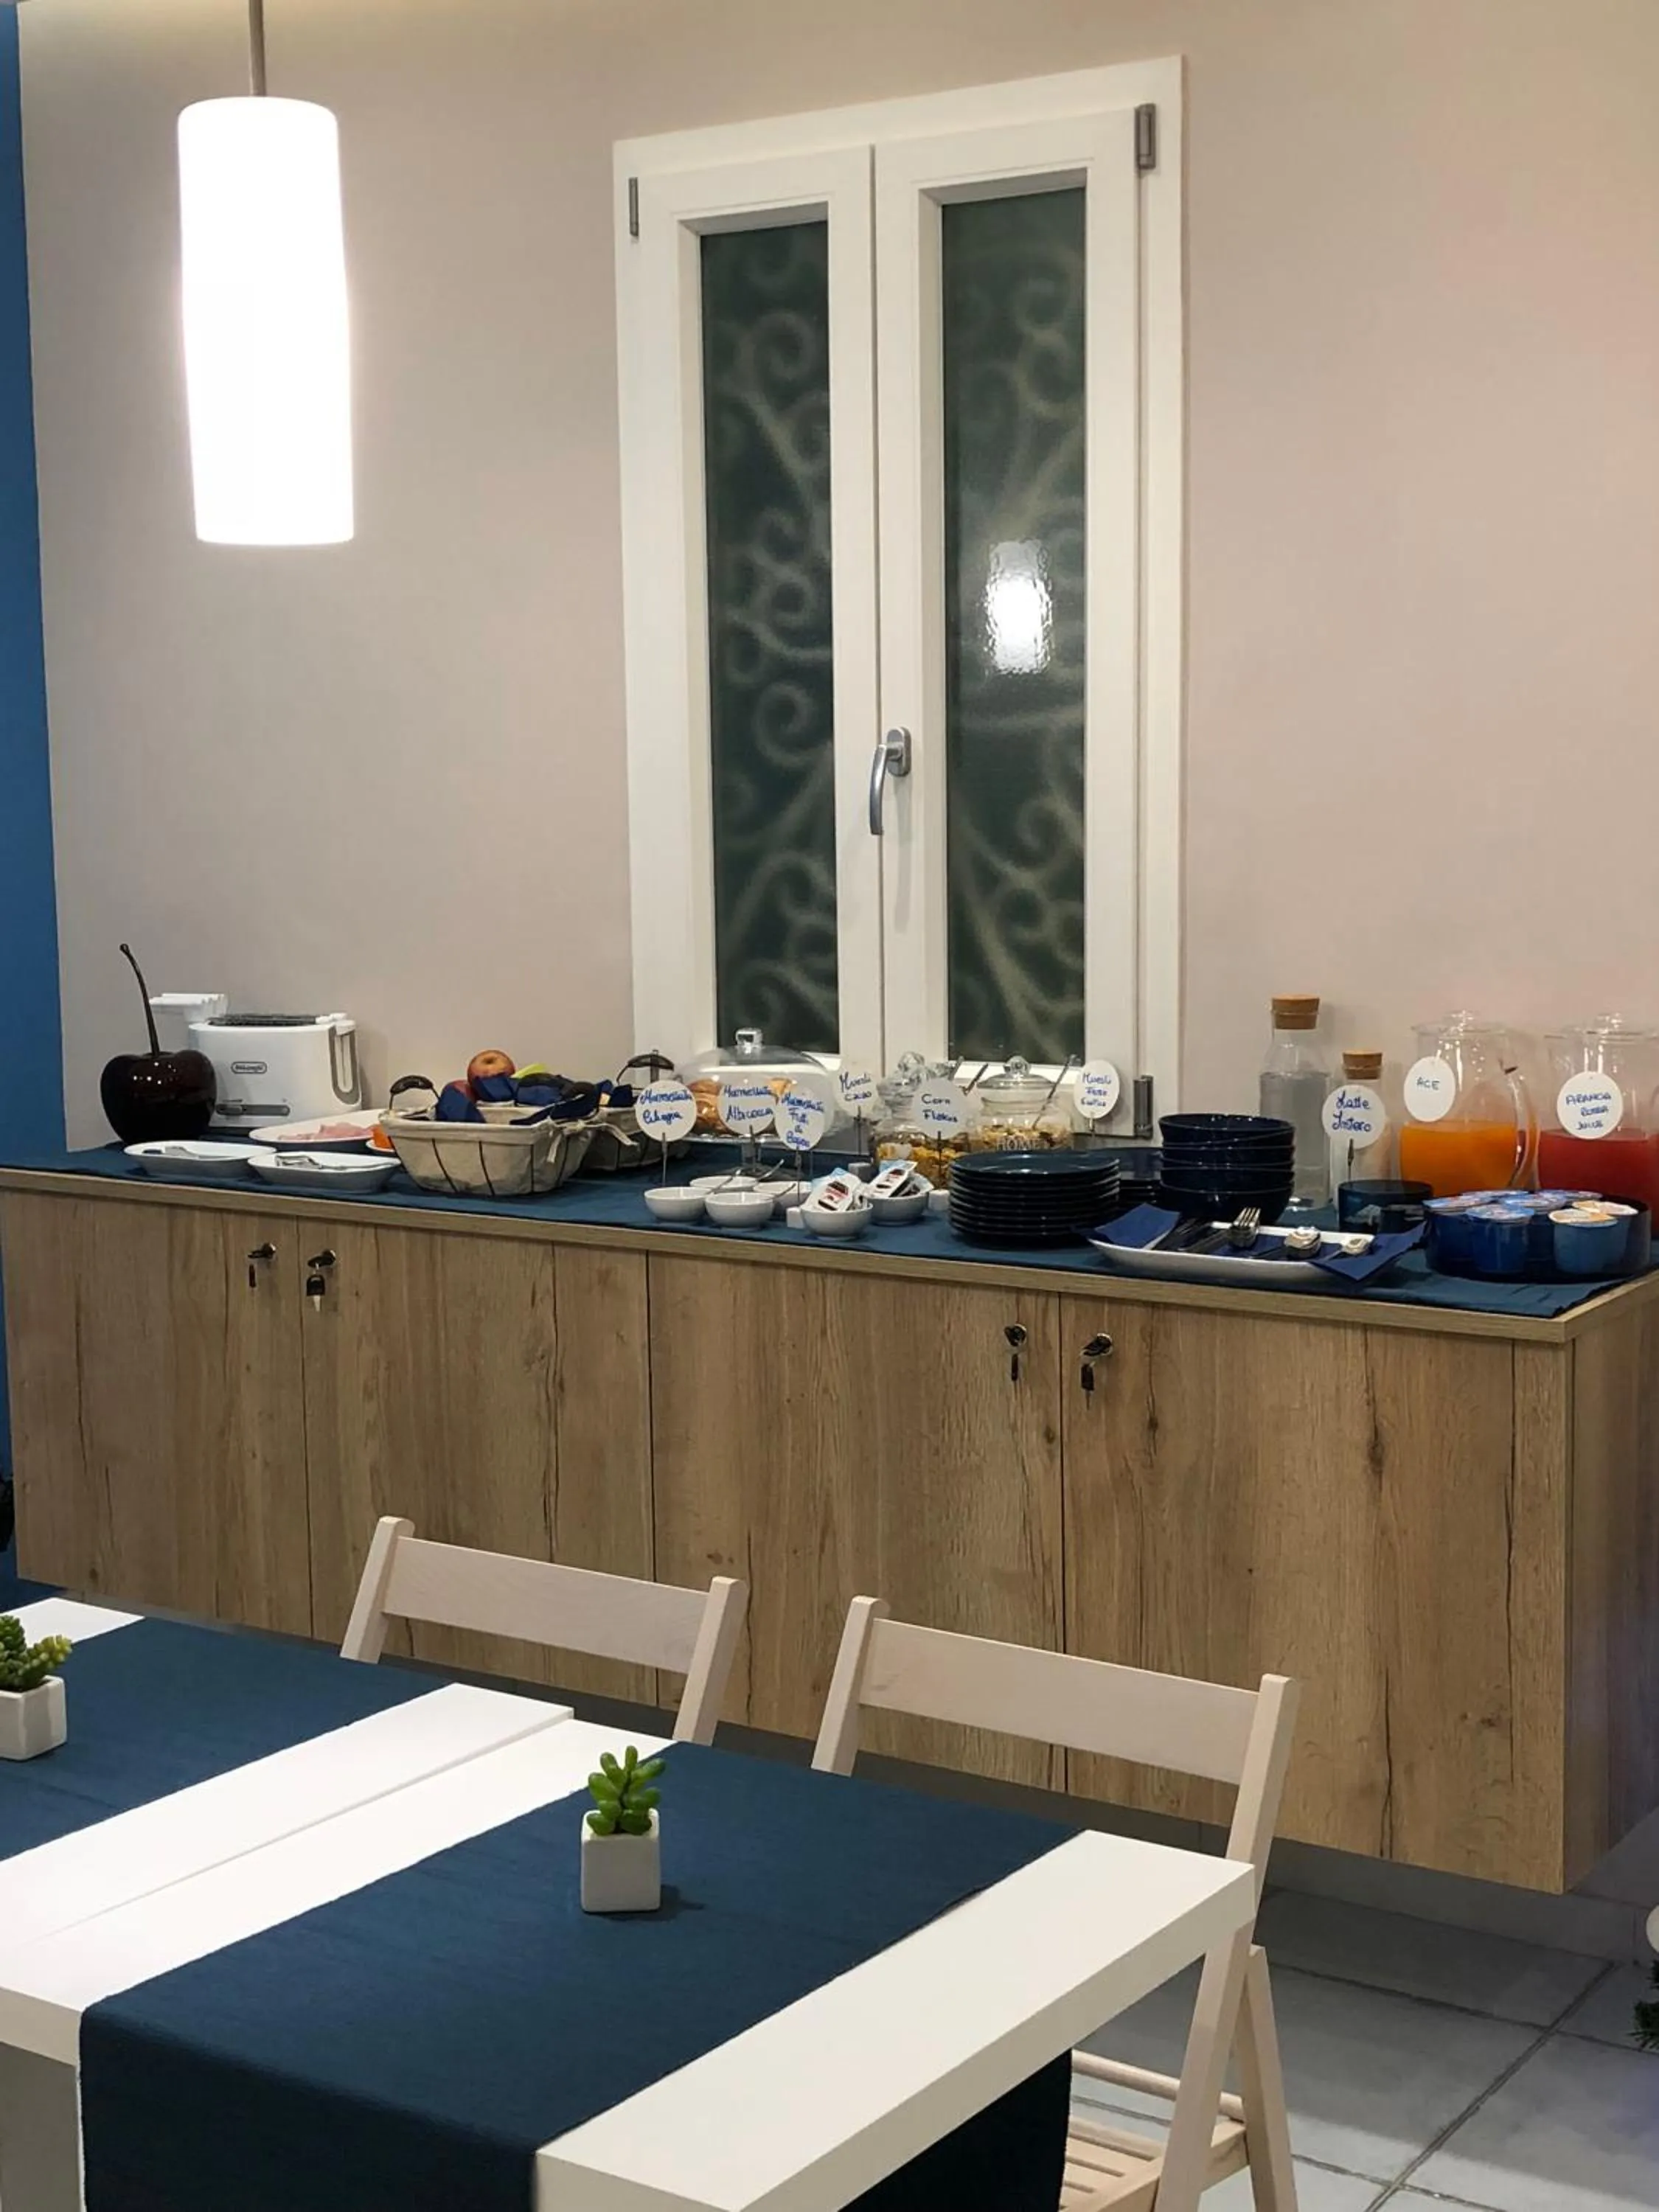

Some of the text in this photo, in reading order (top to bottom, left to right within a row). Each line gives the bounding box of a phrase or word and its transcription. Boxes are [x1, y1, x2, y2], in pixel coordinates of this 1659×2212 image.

[1416, 1076, 1440, 1091] ACE
[922, 1093, 951, 1105] Corn
[1336, 1091, 1371, 1110] Latte
[922, 1109, 958, 1123] Flakes
[1332, 1110, 1372, 1132] Intero
